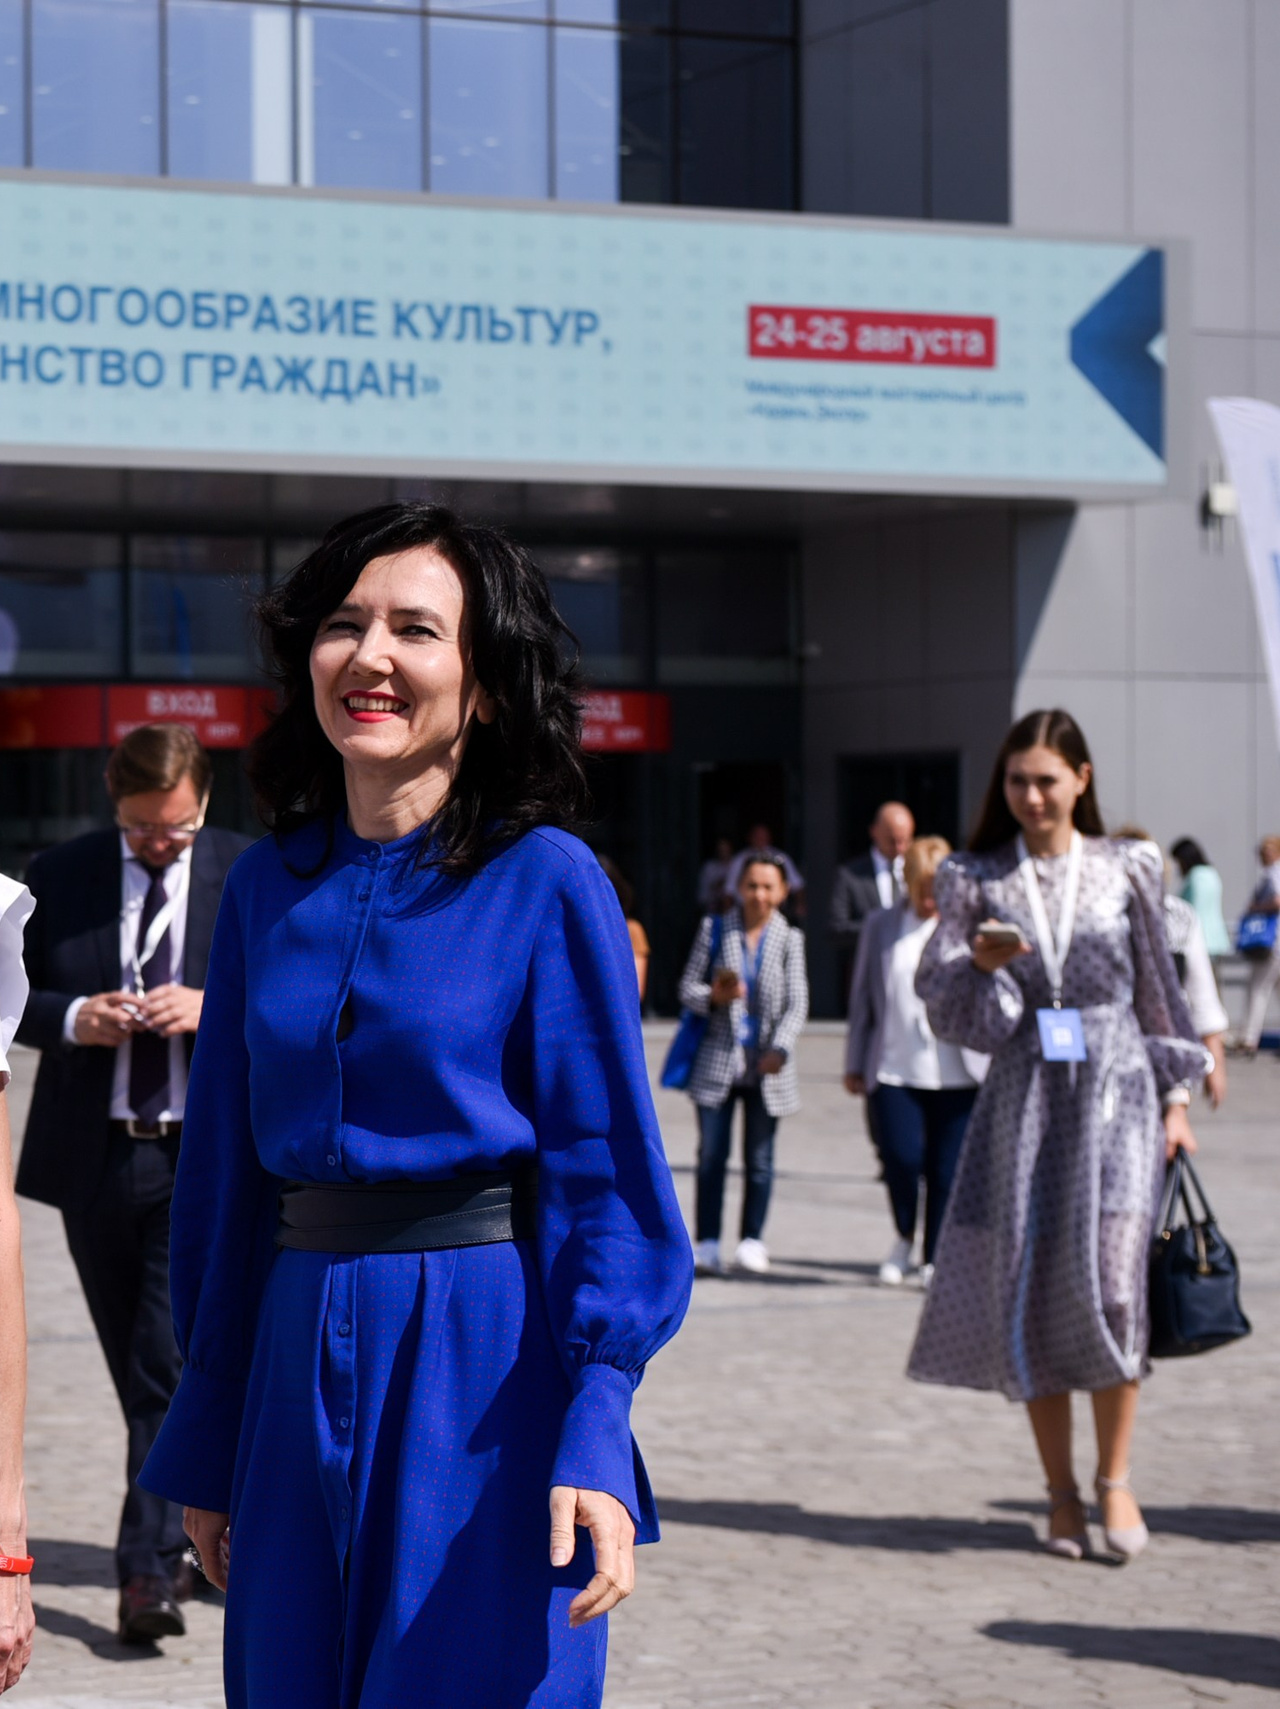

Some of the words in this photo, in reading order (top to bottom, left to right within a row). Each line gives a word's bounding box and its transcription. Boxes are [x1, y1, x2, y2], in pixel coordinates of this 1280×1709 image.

[392, 301, 612, 355] КУЛЬТУР,
[755, 313, 848, 351] 24-25
[856, 325, 987, 362] августа
[147, 690, 218, 718] ВХОД
